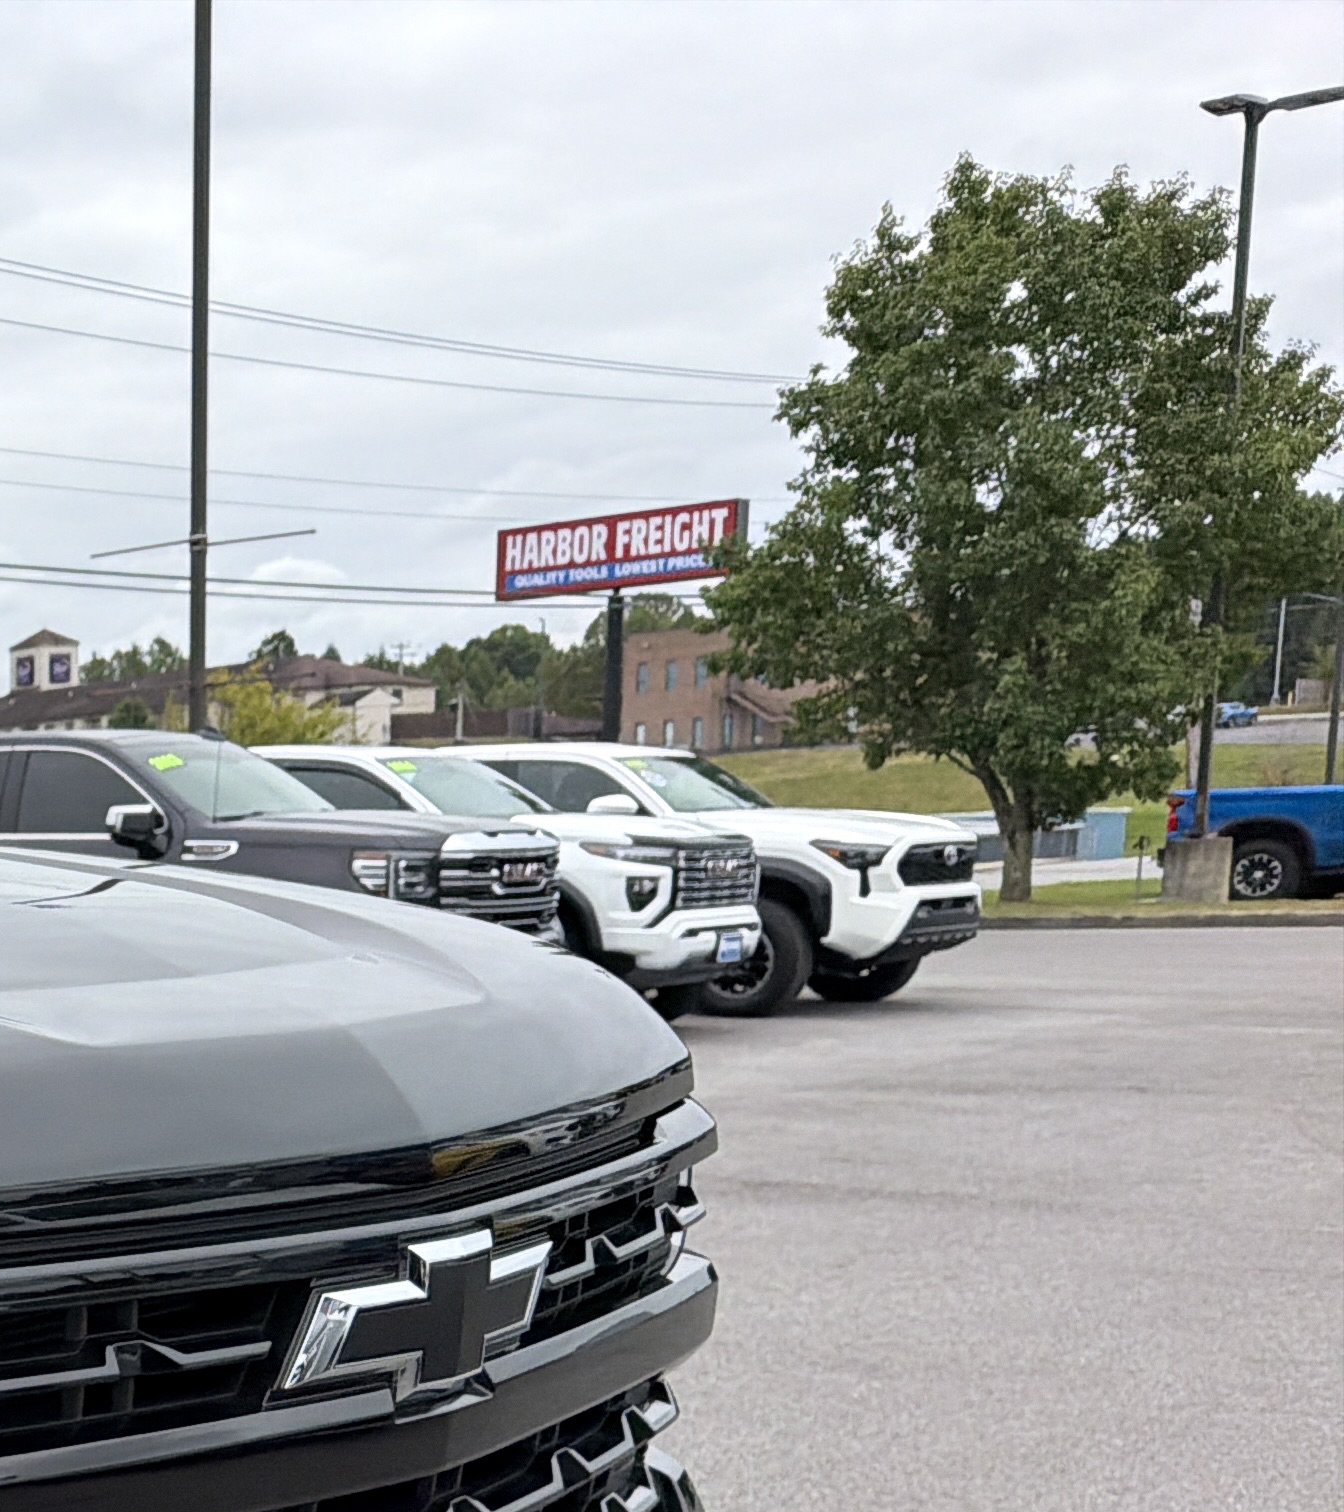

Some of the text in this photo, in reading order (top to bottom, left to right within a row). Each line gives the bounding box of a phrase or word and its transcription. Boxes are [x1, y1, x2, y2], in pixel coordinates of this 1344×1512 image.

[505, 507, 729, 572] HARBOR FREIGHT
[514, 570, 569, 588] QUALITY
[569, 563, 609, 581] TOOLS
[615, 557, 664, 576] LOWEST
